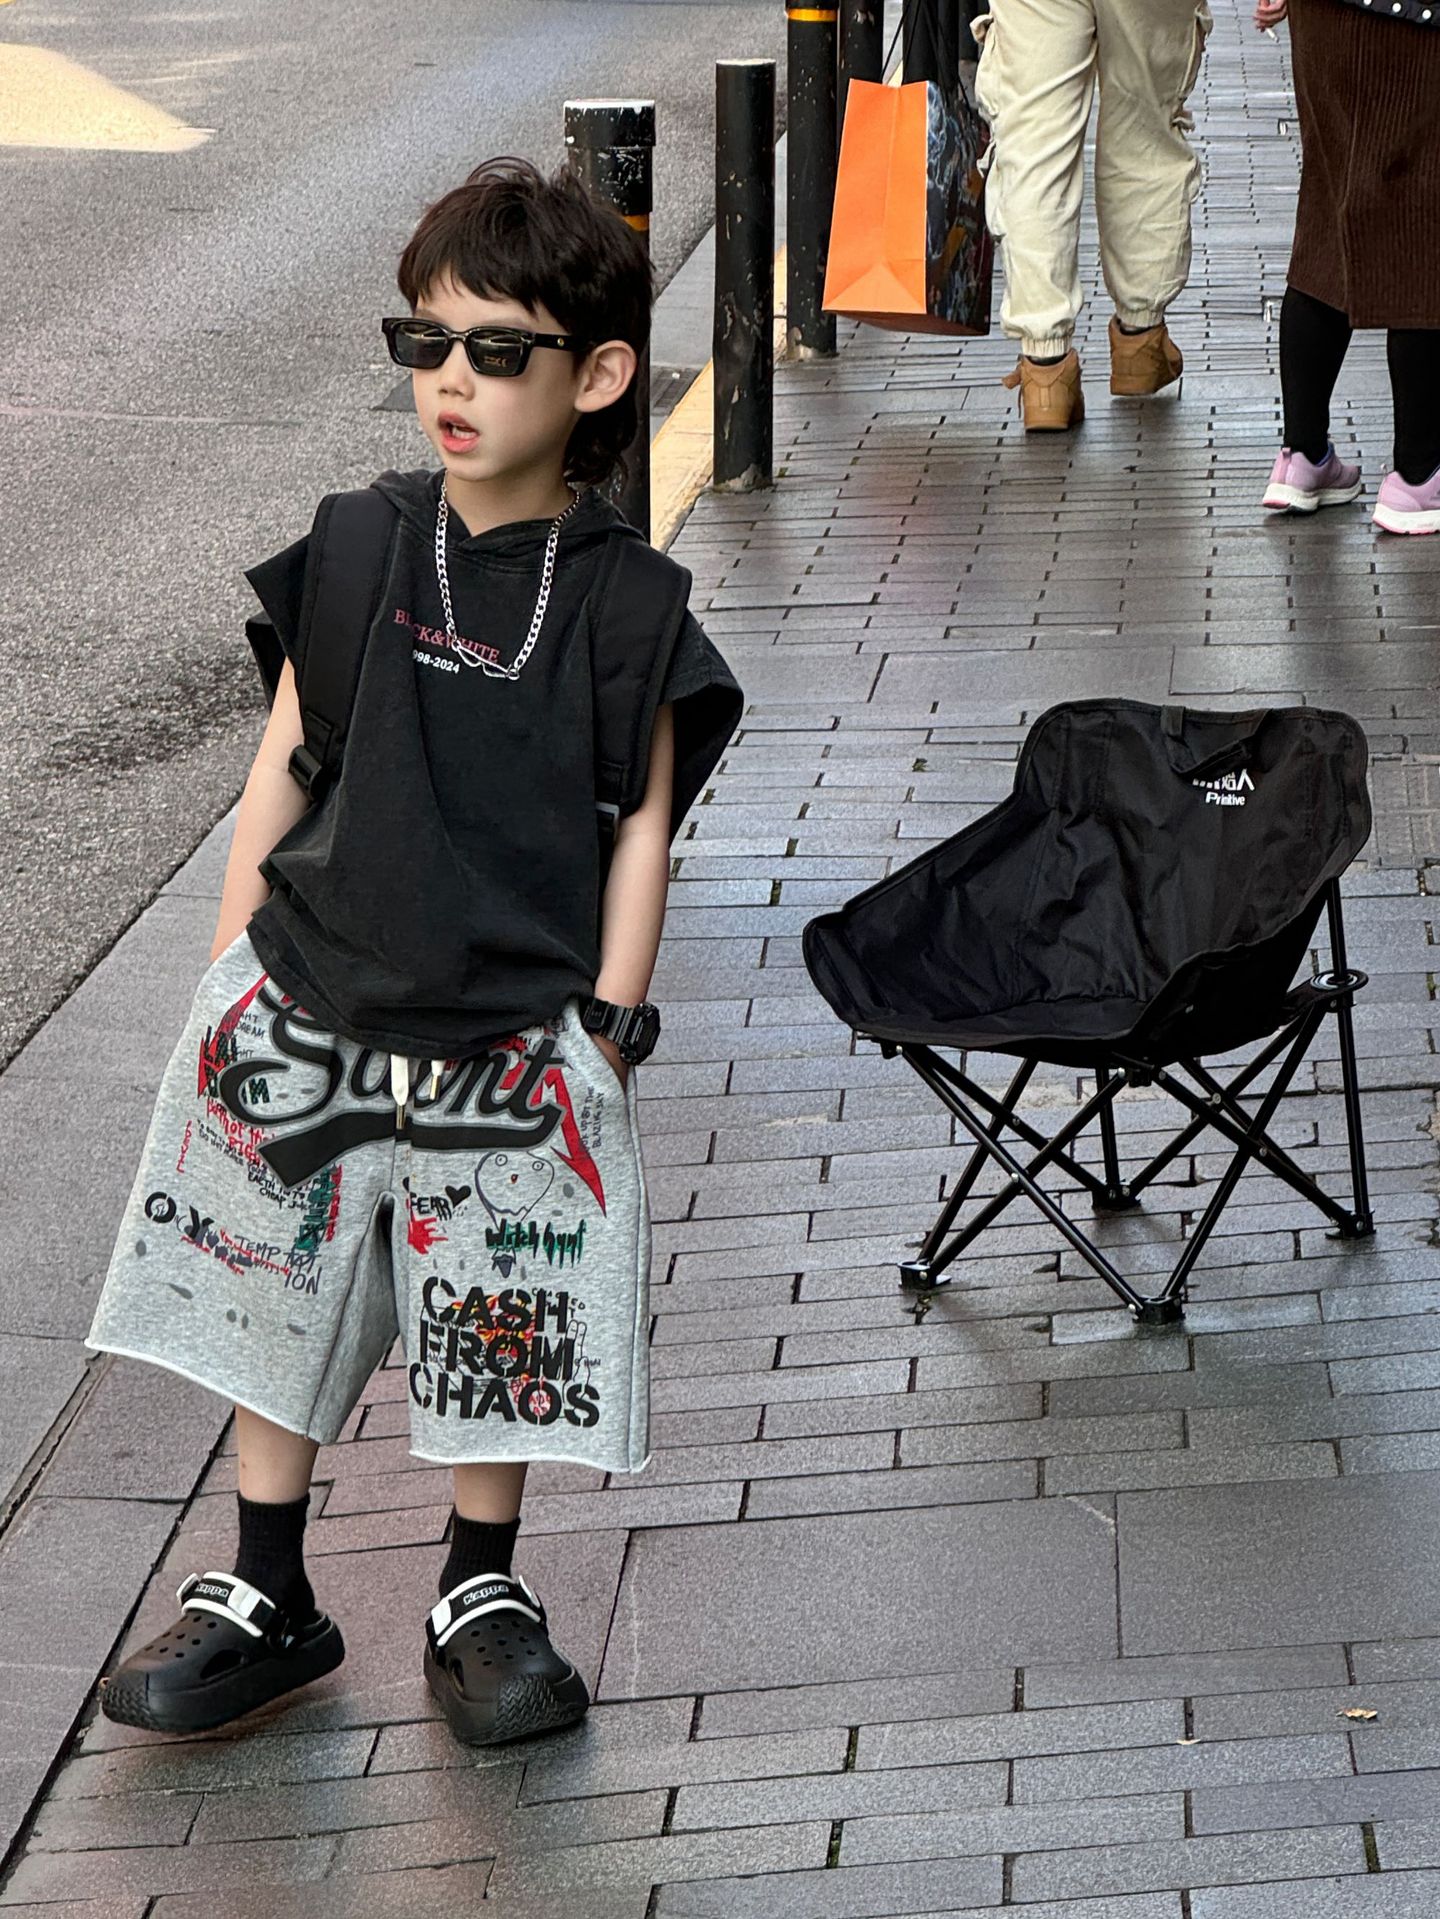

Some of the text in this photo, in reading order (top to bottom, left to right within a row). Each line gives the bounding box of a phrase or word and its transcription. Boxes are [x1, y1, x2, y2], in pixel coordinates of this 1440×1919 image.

[412, 649, 460, 675] 998-2024
[422, 1276, 569, 1333] CASH
[419, 1319, 575, 1381] FROM
[409, 1362, 600, 1428] CHAOS
[462, 1584, 510, 1606] Kappa
